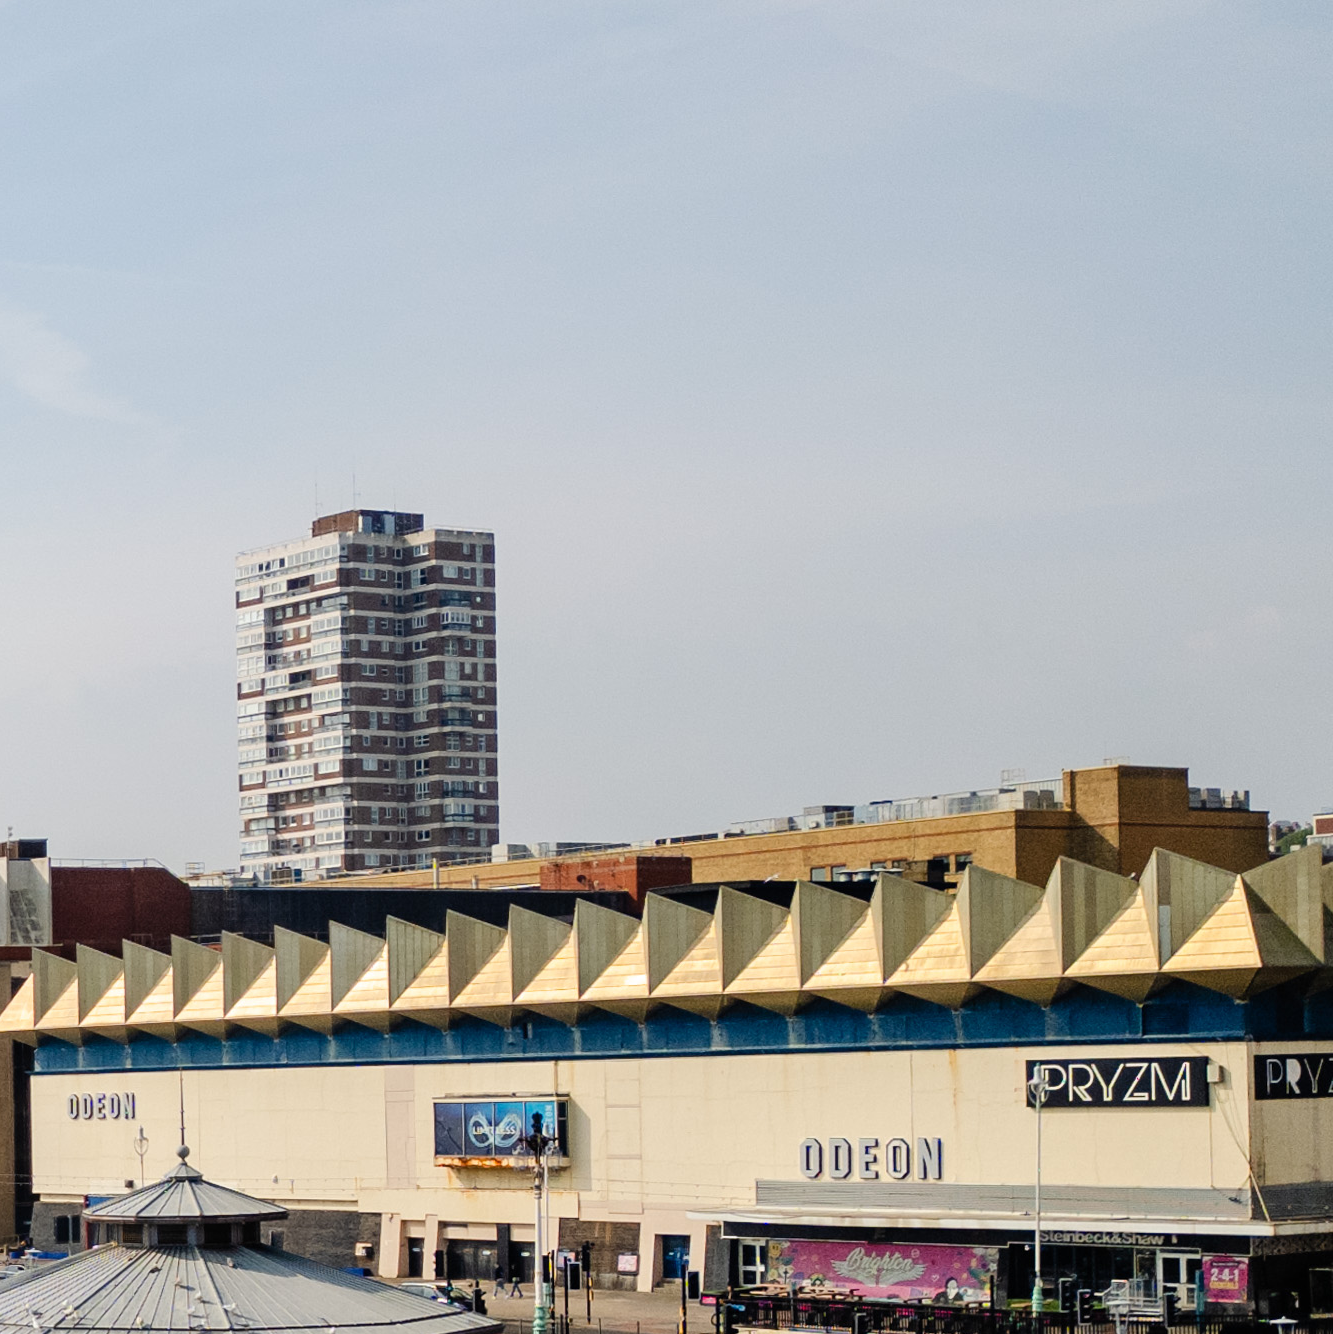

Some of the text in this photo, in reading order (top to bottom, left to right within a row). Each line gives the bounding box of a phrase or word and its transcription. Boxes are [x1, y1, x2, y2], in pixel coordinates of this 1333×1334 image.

[1040, 1062, 1191, 1102] PRYZM
[1266, 1058, 1333, 1095] PRY
[68, 1092, 136, 1120] ODEON
[799, 1137, 945, 1180] ODEON
[844, 1246, 914, 1275] Brighton
[1210, 1267, 1240, 1282] 2-4-1
